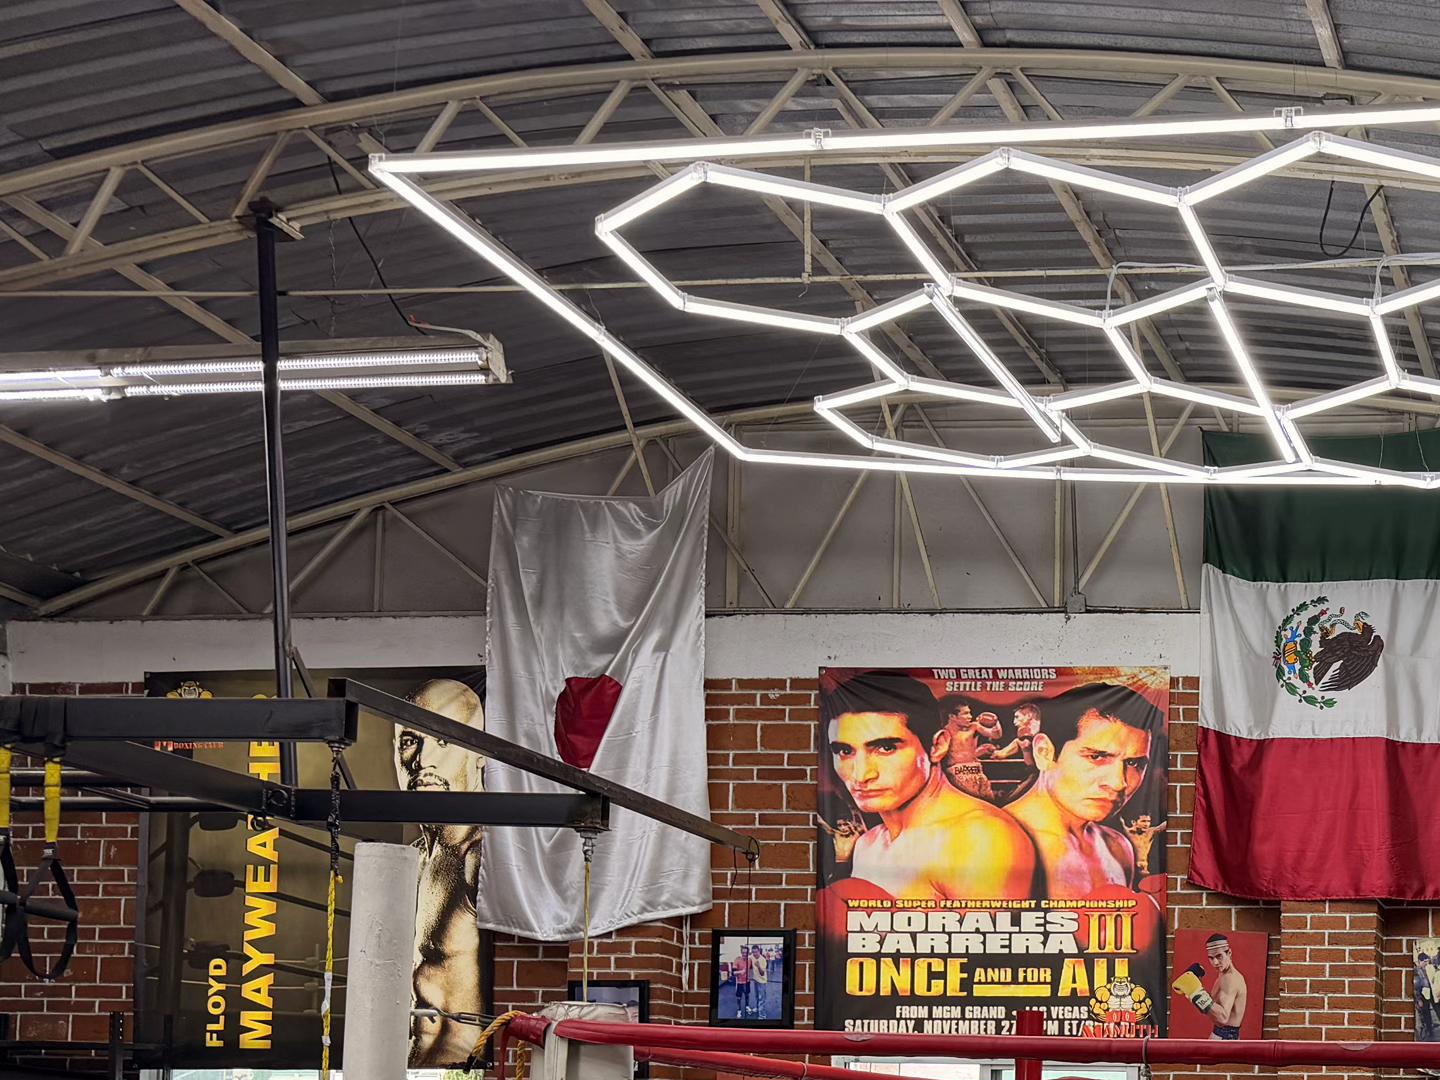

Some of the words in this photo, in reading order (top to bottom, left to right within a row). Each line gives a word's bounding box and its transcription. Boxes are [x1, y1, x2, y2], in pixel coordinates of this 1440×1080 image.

[932, 669, 957, 680] TWO
[960, 669, 993, 680] GREAT
[997, 668, 1057, 680] WARRIORS
[945, 680, 982, 692] SETTLE
[986, 680, 1006, 692] THE
[1008, 680, 1044, 692] SCORE
[239, 694, 281, 1049] MAYWEAHE
[848, 899, 893, 909] WORLD
[895, 899, 937, 909] SUPER
[939, 899, 1036, 909] FEATHERWEIGHT
[1040, 899, 1137, 909] CHAMPIONSHIP
[847, 911, 1079, 932] MORALES
[1083, 911, 1137, 954] III
[847, 933, 1078, 954] BARRERA
[845, 957, 968, 997] ONCE
[973, 967, 1012, 983] AND
[1017, 967, 1052, 983] FOR
[206, 957, 228, 1047] FLOYD
[896, 1006, 929, 1019] FROM
[932, 1006, 963, 1019] MGM
[965, 1006, 1006, 1019] GRAND
[1051, 1006, 1088, 1019] VEGAS
[924, 1020, 996, 1035] NOVEMBER
